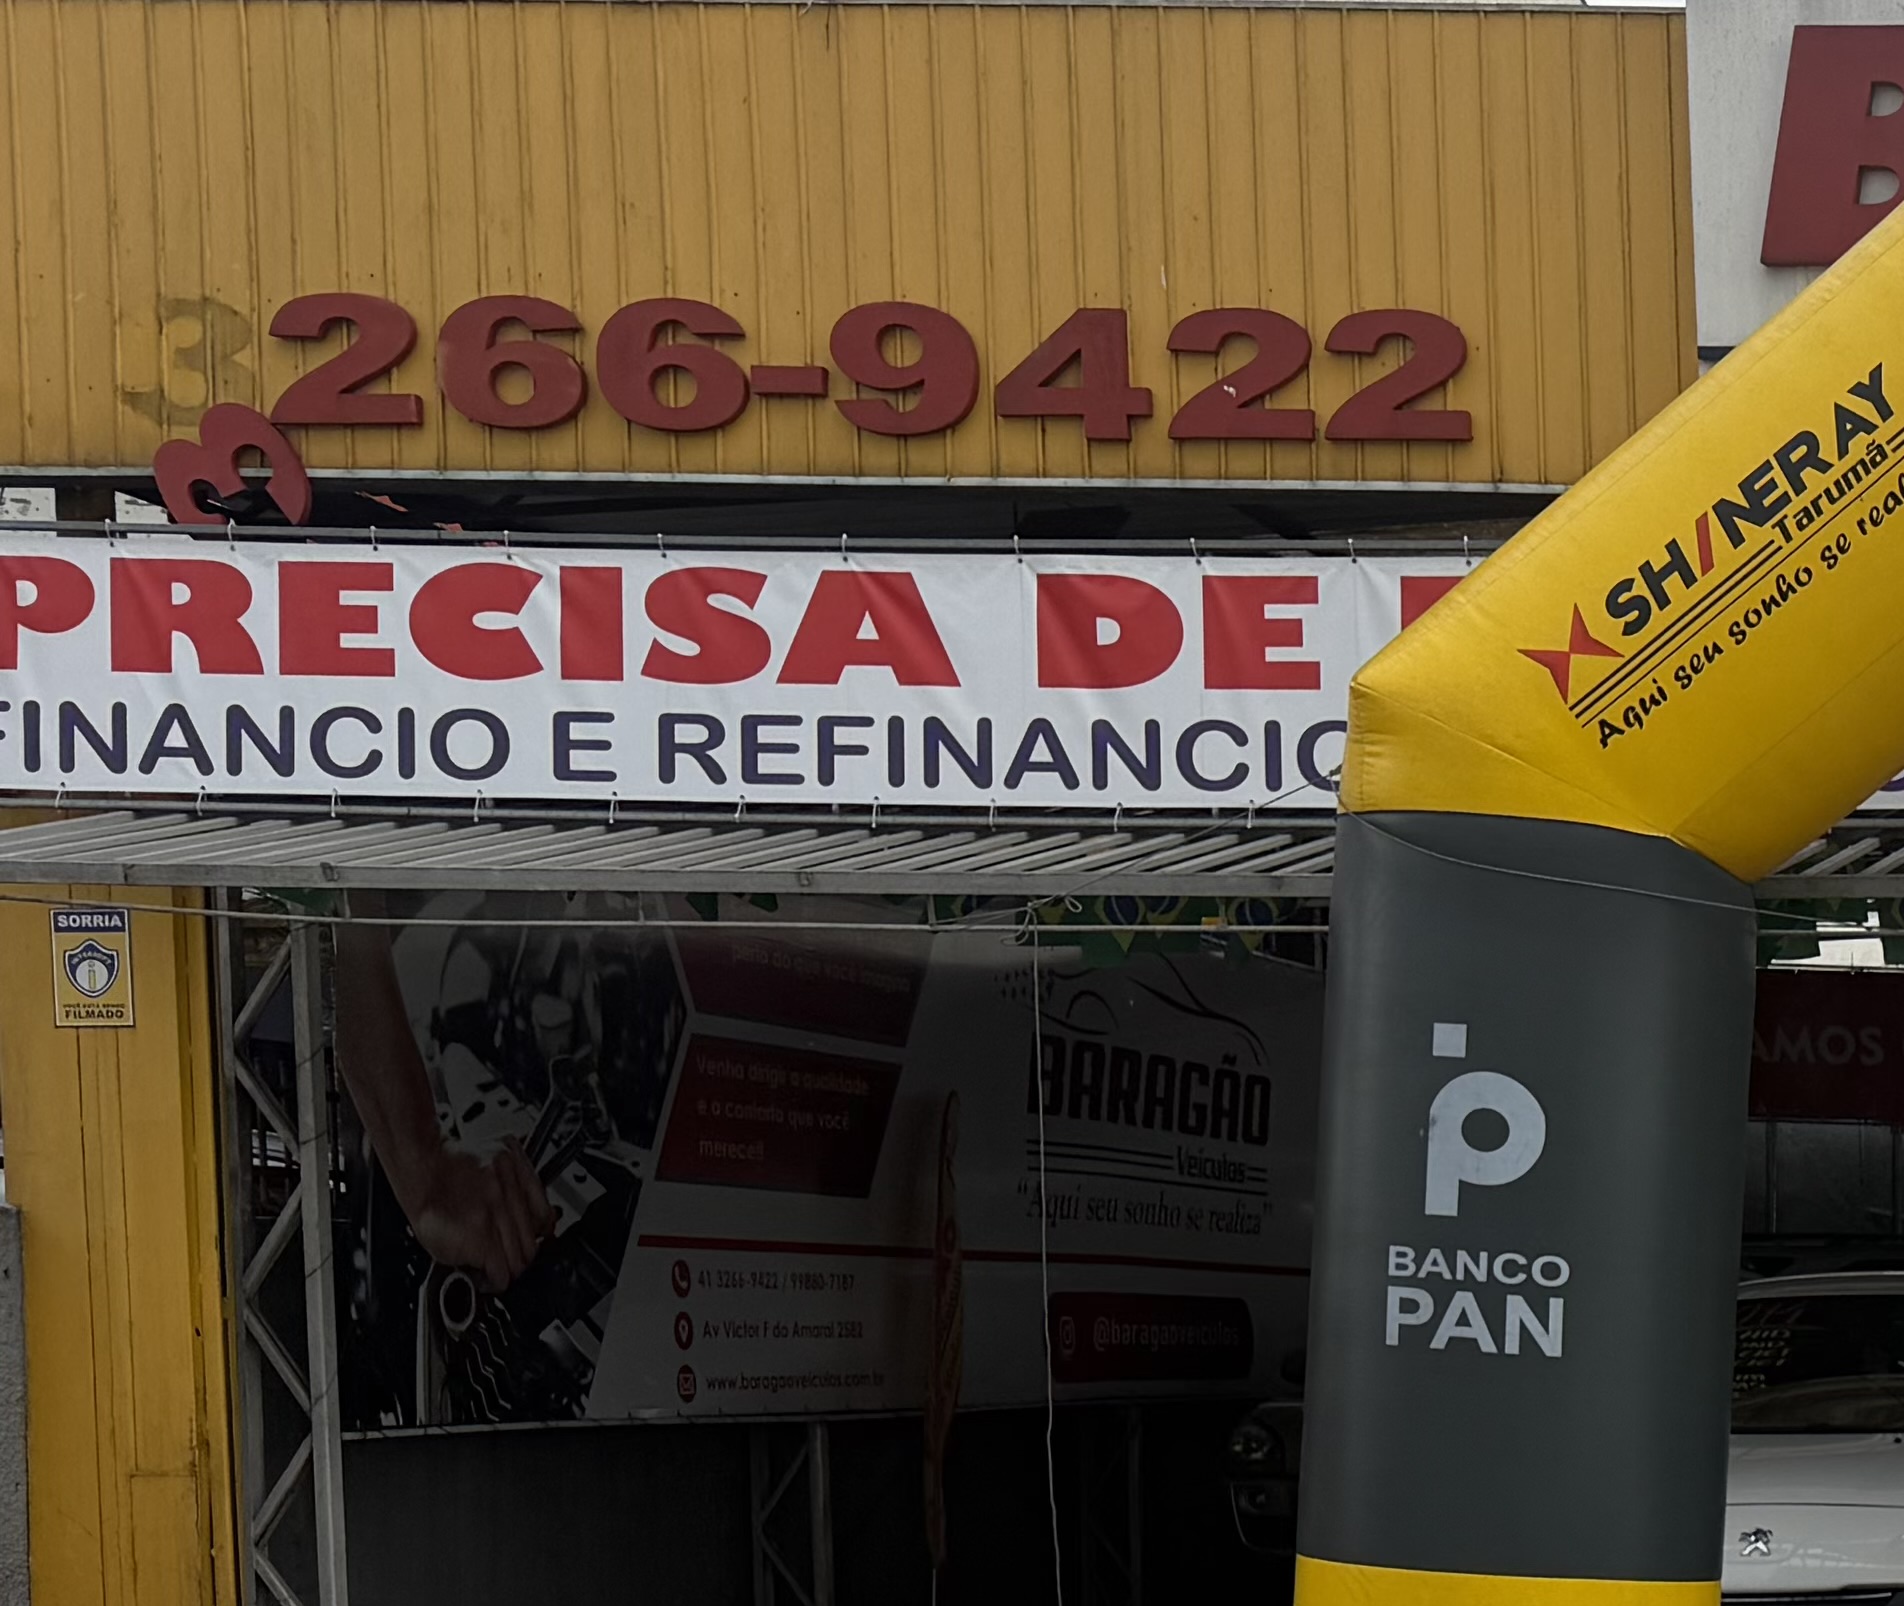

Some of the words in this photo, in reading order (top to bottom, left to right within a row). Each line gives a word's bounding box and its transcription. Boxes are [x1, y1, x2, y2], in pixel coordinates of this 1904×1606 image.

[1605, 362, 1894, 636] SHINERAY
[1771, 439, 1889, 544] Tarumã
[0, 556, 961, 687] PRECISA
[1036, 574, 1322, 691] DE
[1599, 678, 1668, 749] Aqui
[1674, 641, 1723, 690] seu
[1727, 567, 1813, 645] sonho
[1820, 533, 1852, 570] se
[0, 700, 511, 781] INANCIO
[553, 711, 618, 783] E
[57, 914, 122, 927] SORRIA
[64, 1009, 124, 1020] FILMADO
[1027, 1033, 1271, 1147] BARAGÃO
[1387, 1244, 1571, 1288] BANCO
[1385, 1284, 1565, 1358] PAN
